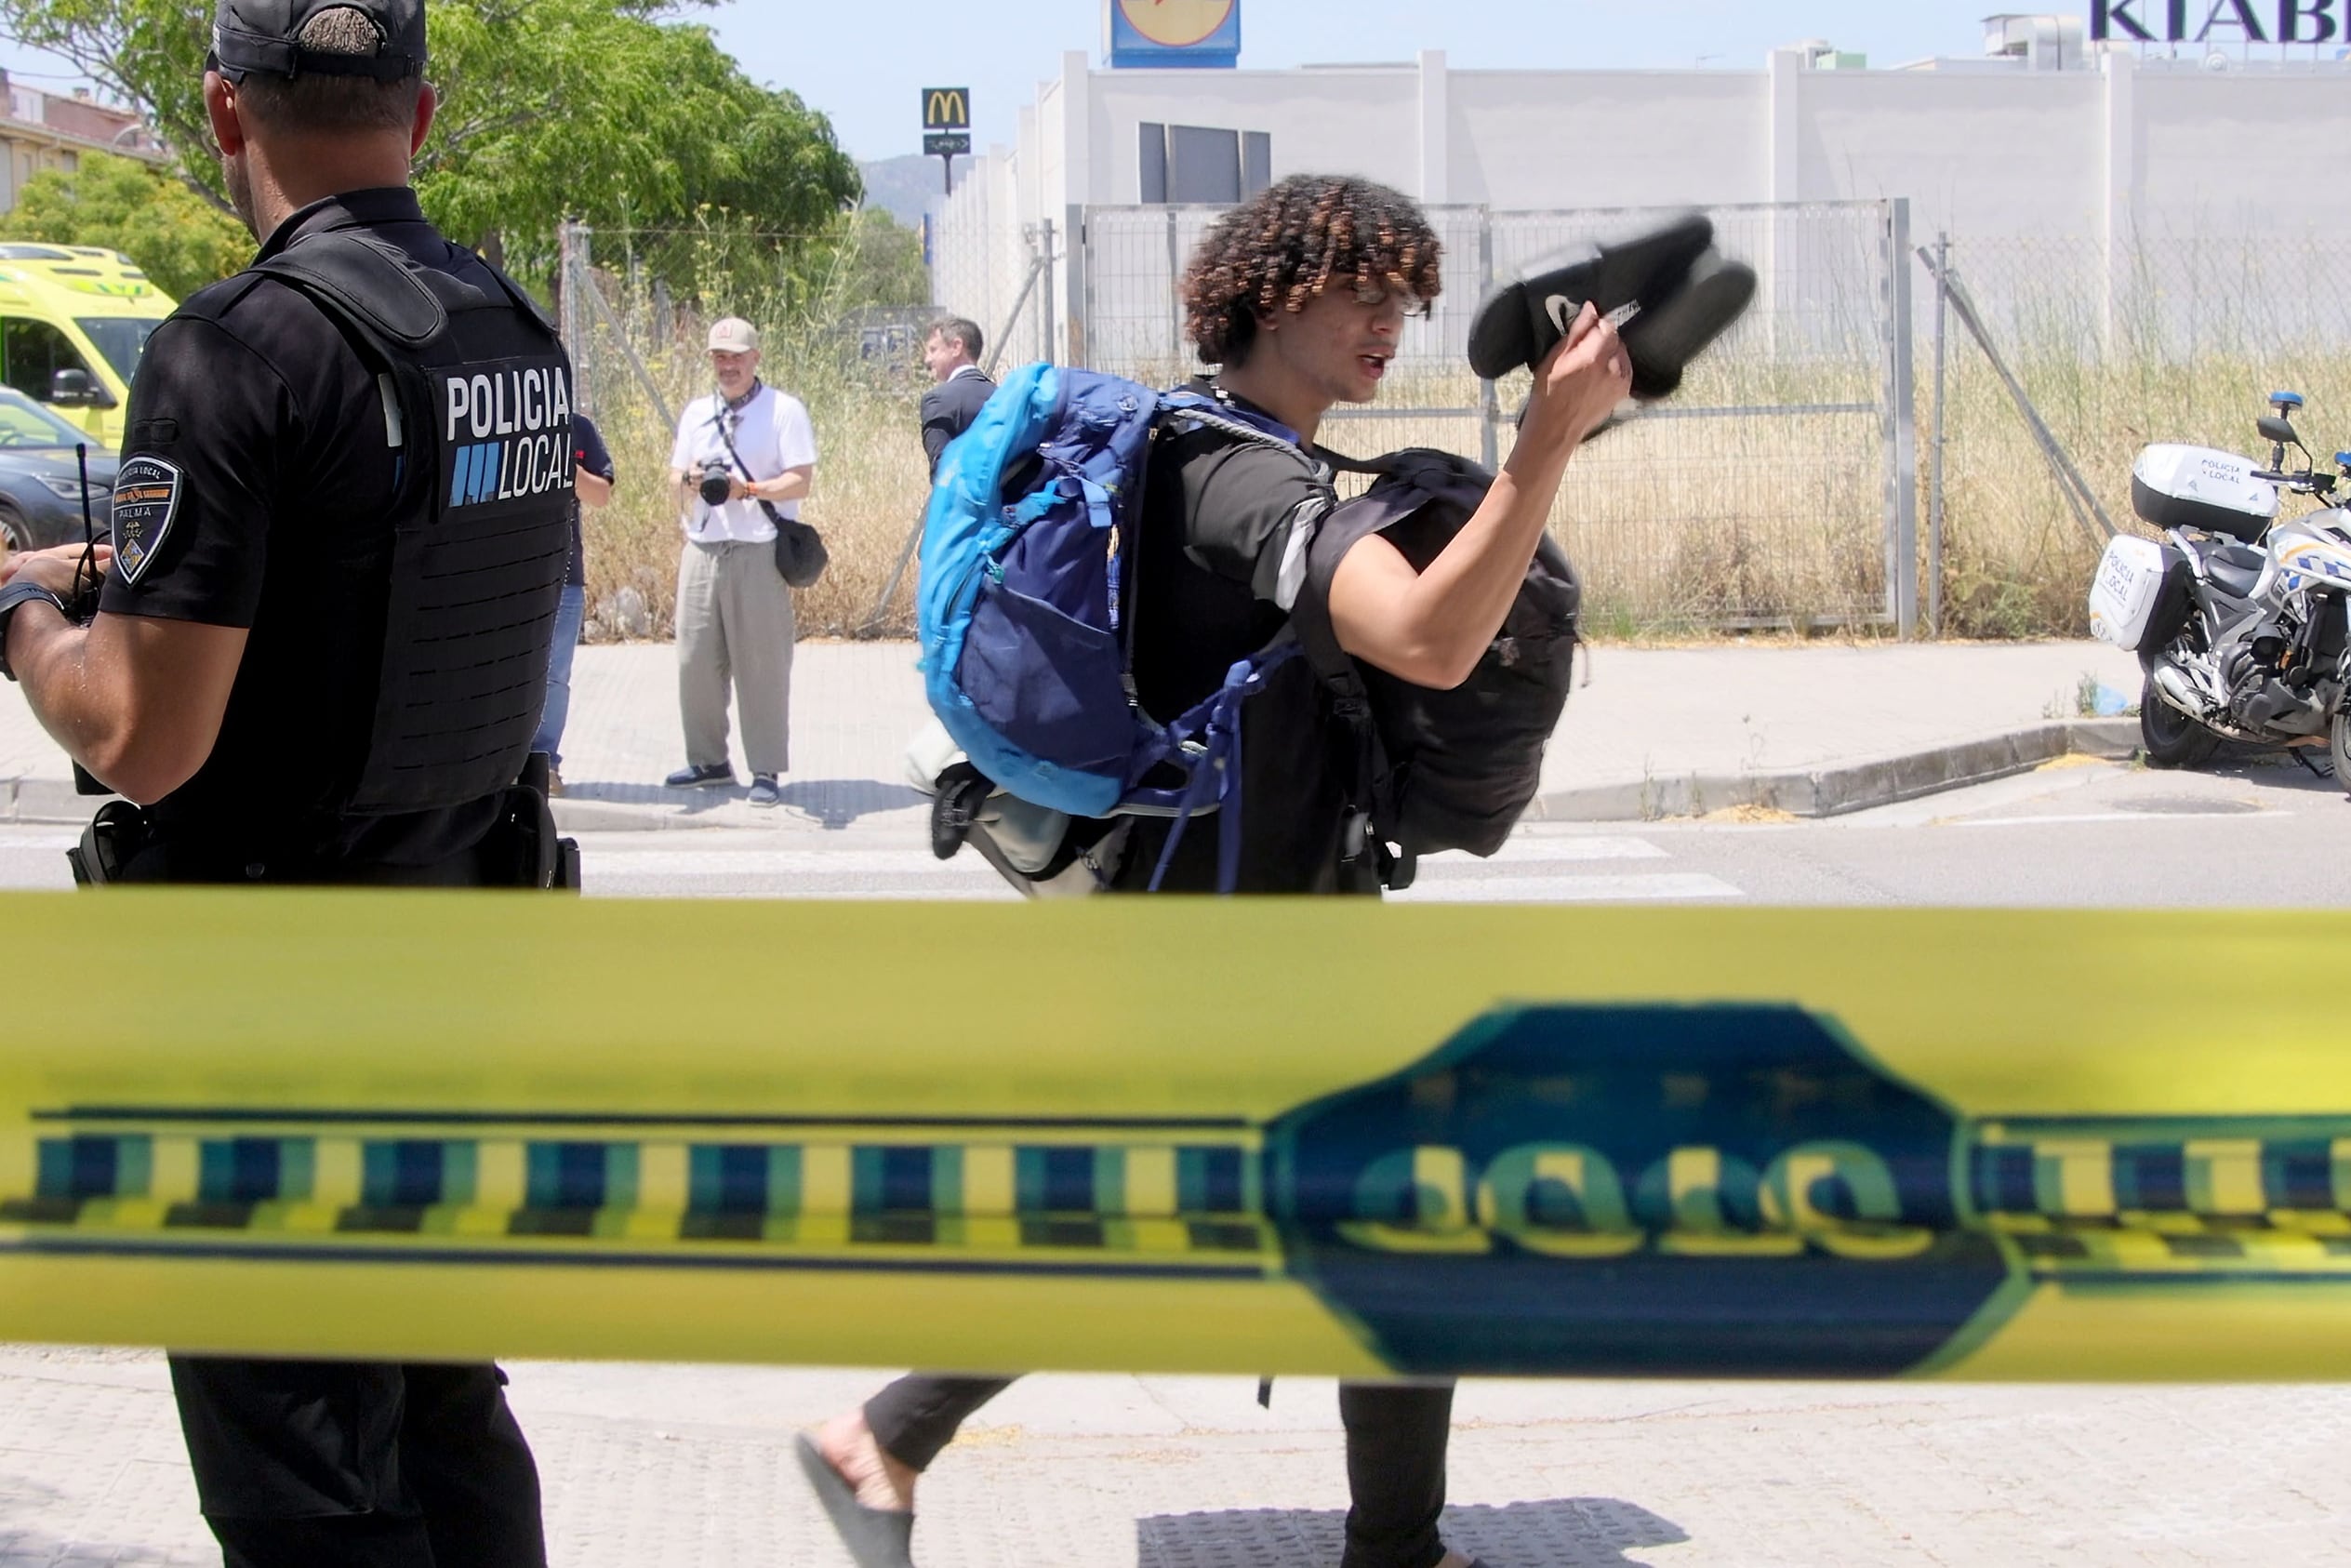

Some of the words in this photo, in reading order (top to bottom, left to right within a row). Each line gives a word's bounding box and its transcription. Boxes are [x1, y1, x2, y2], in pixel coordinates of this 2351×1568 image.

[2091, 0, 2351, 44] KIAB
[446, 366, 570, 441] POLICIA
[139, 466, 161, 480] LOCAL
[498, 432, 573, 500] LOCAL
[2201, 458, 2240, 473] POLICIA
[2209, 471, 2240, 485] LOCAL
[119, 507, 151, 518] PALMA
